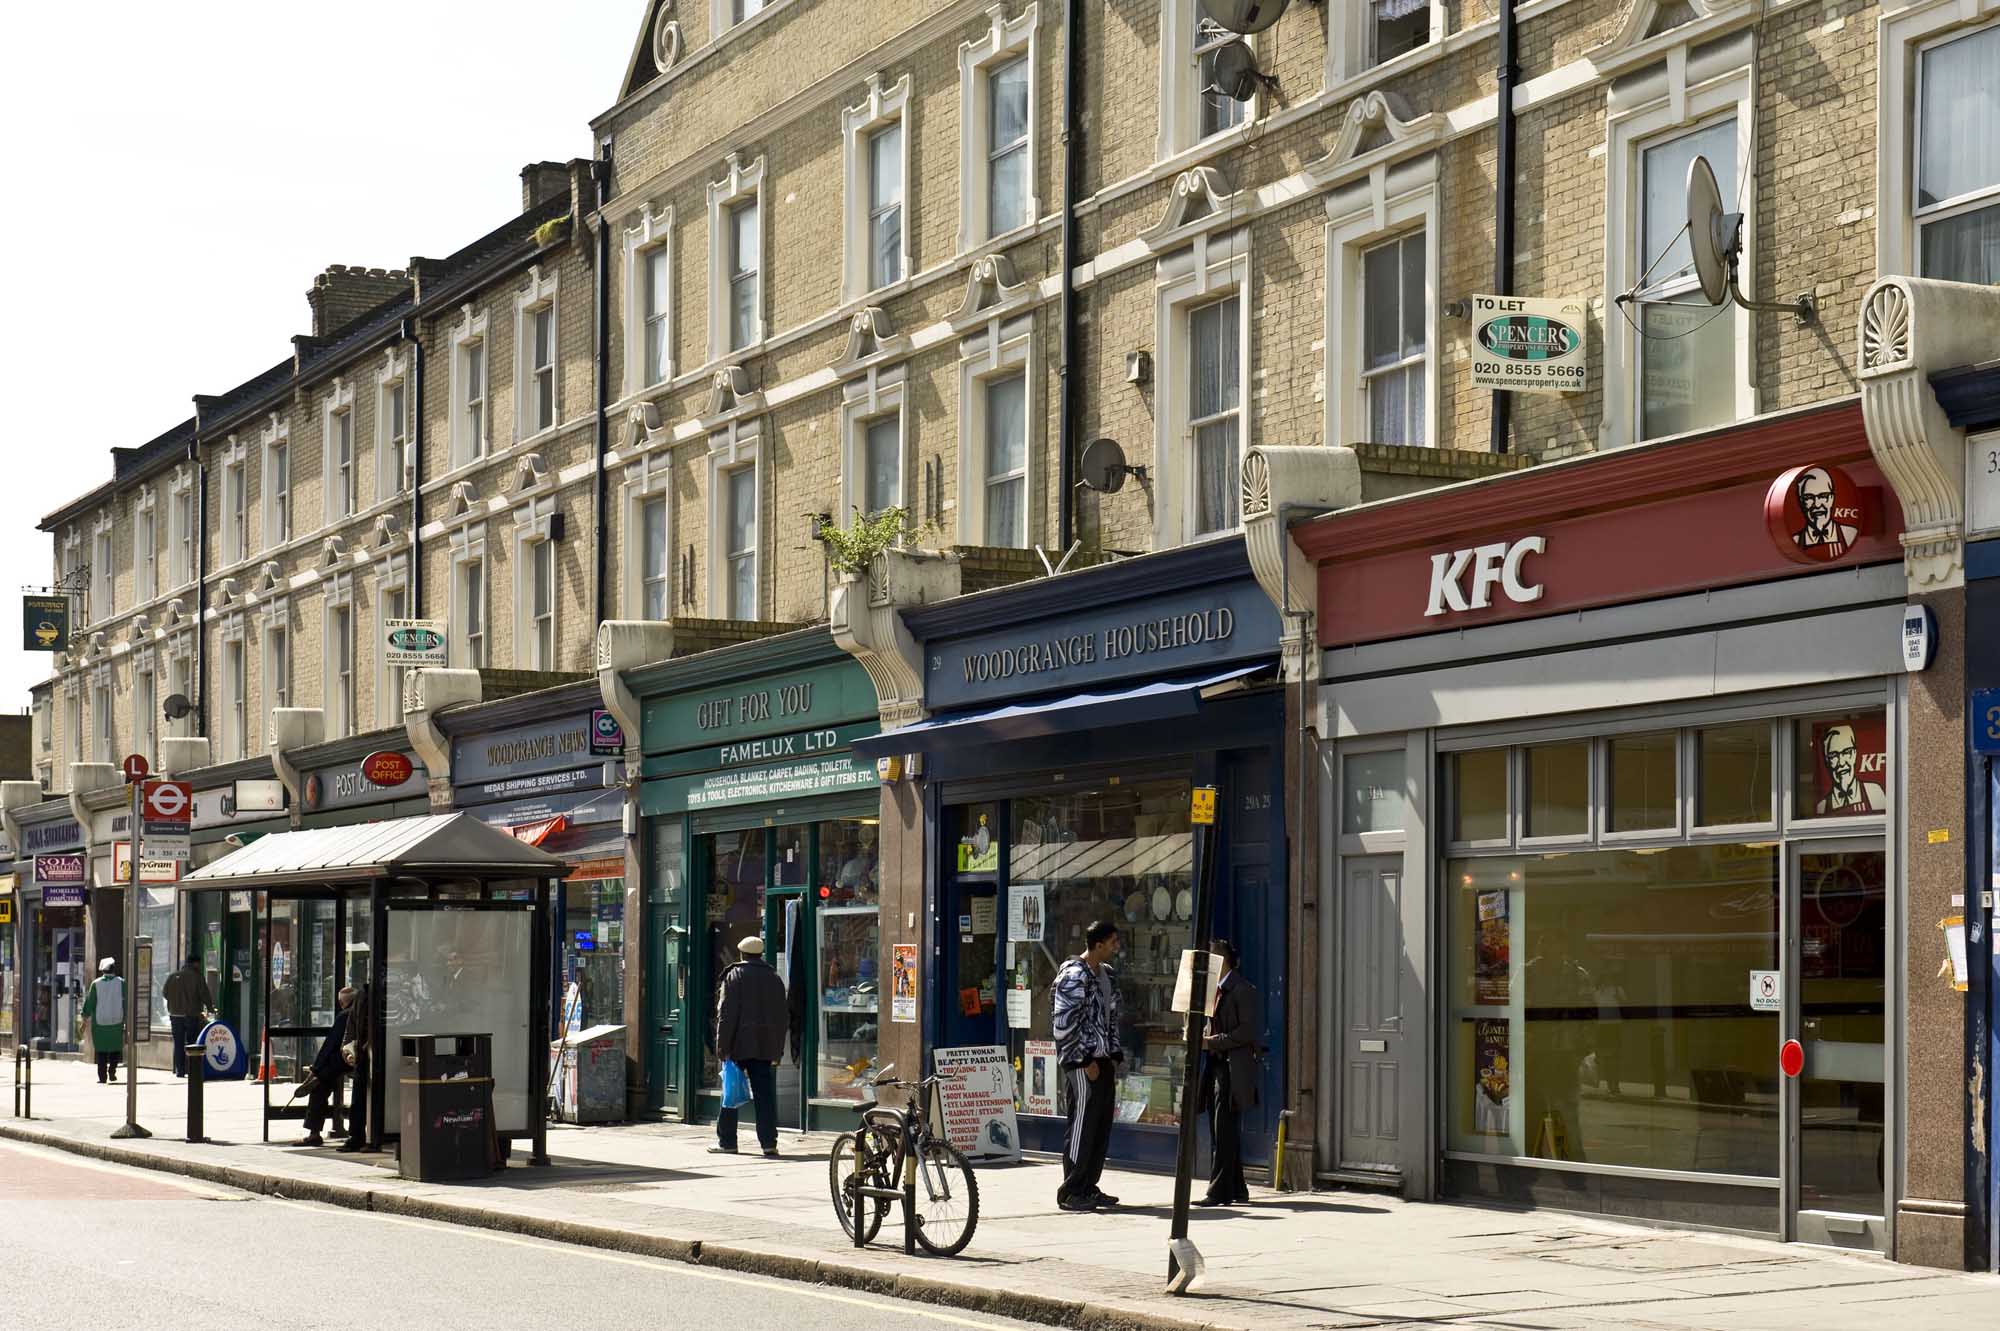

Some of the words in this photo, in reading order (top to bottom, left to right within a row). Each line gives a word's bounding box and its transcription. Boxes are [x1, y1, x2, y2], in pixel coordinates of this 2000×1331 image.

[1476, 298, 1494, 310] TO
[1499, 300, 1525, 312] LET
[1486, 321, 1570, 352] SPENCERS
[1475, 362, 1500, 374] 020
[1505, 364, 1542, 376] 8555
[1547, 365, 1584, 377] 5666
[1475, 376, 1581, 388] www.spencersproperty.co.uk
[1835, 508, 1859, 519] KFC
[1424, 536, 1547, 617] KFC
[393, 632, 440, 646] SPENCERS
[963, 633, 1096, 683] WOODGRANGE
[1104, 607, 1235, 660] HOUSEHOLD
[932, 655, 942, 671] 29
[697, 698, 732, 730] GIFT
[739, 691, 770, 723] FOR
[777, 683, 812, 716] YOU
[487, 735, 555, 767] WOODGRANGE
[558, 728, 587, 753] NEWS
[720, 737, 794, 764] FAMELUX
[805, 730, 837, 750] LTD
[132, 758, 141, 775] L
[375, 760, 400, 769] POST
[371, 770, 406, 779] OFFICE
[484, 783, 505, 793] MEDAS
[506, 779, 537, 790] SHIPPING
[537, 773, 570, 786] SERVICES
[571, 770, 587, 780] LTD.
[704, 774, 739, 789] HOUSEHOLD,
[740, 771, 768, 785] BLANKET,
[768, 767, 793, 781] CARPET,
[794, 763, 820, 777] BADING,
[821, 759, 853, 774] TOILETRY,
[336, 771, 356, 797] POST
[688, 793, 702, 804] TOYS
[707, 788, 727, 801] TOOLS,
[728, 784, 769, 799] ELECTRONICS,
[769, 778, 814, 794] KITCHENWARE
[820, 775, 836, 787] GIFT
[836, 773, 857, 785] ITEMS
[857, 770, 874, 783] ETC.
[38, 857, 81, 866] SOLA
[970, 1056, 1006, 1064] PARLOUR
[1029, 1096, 1051, 1106] Open
